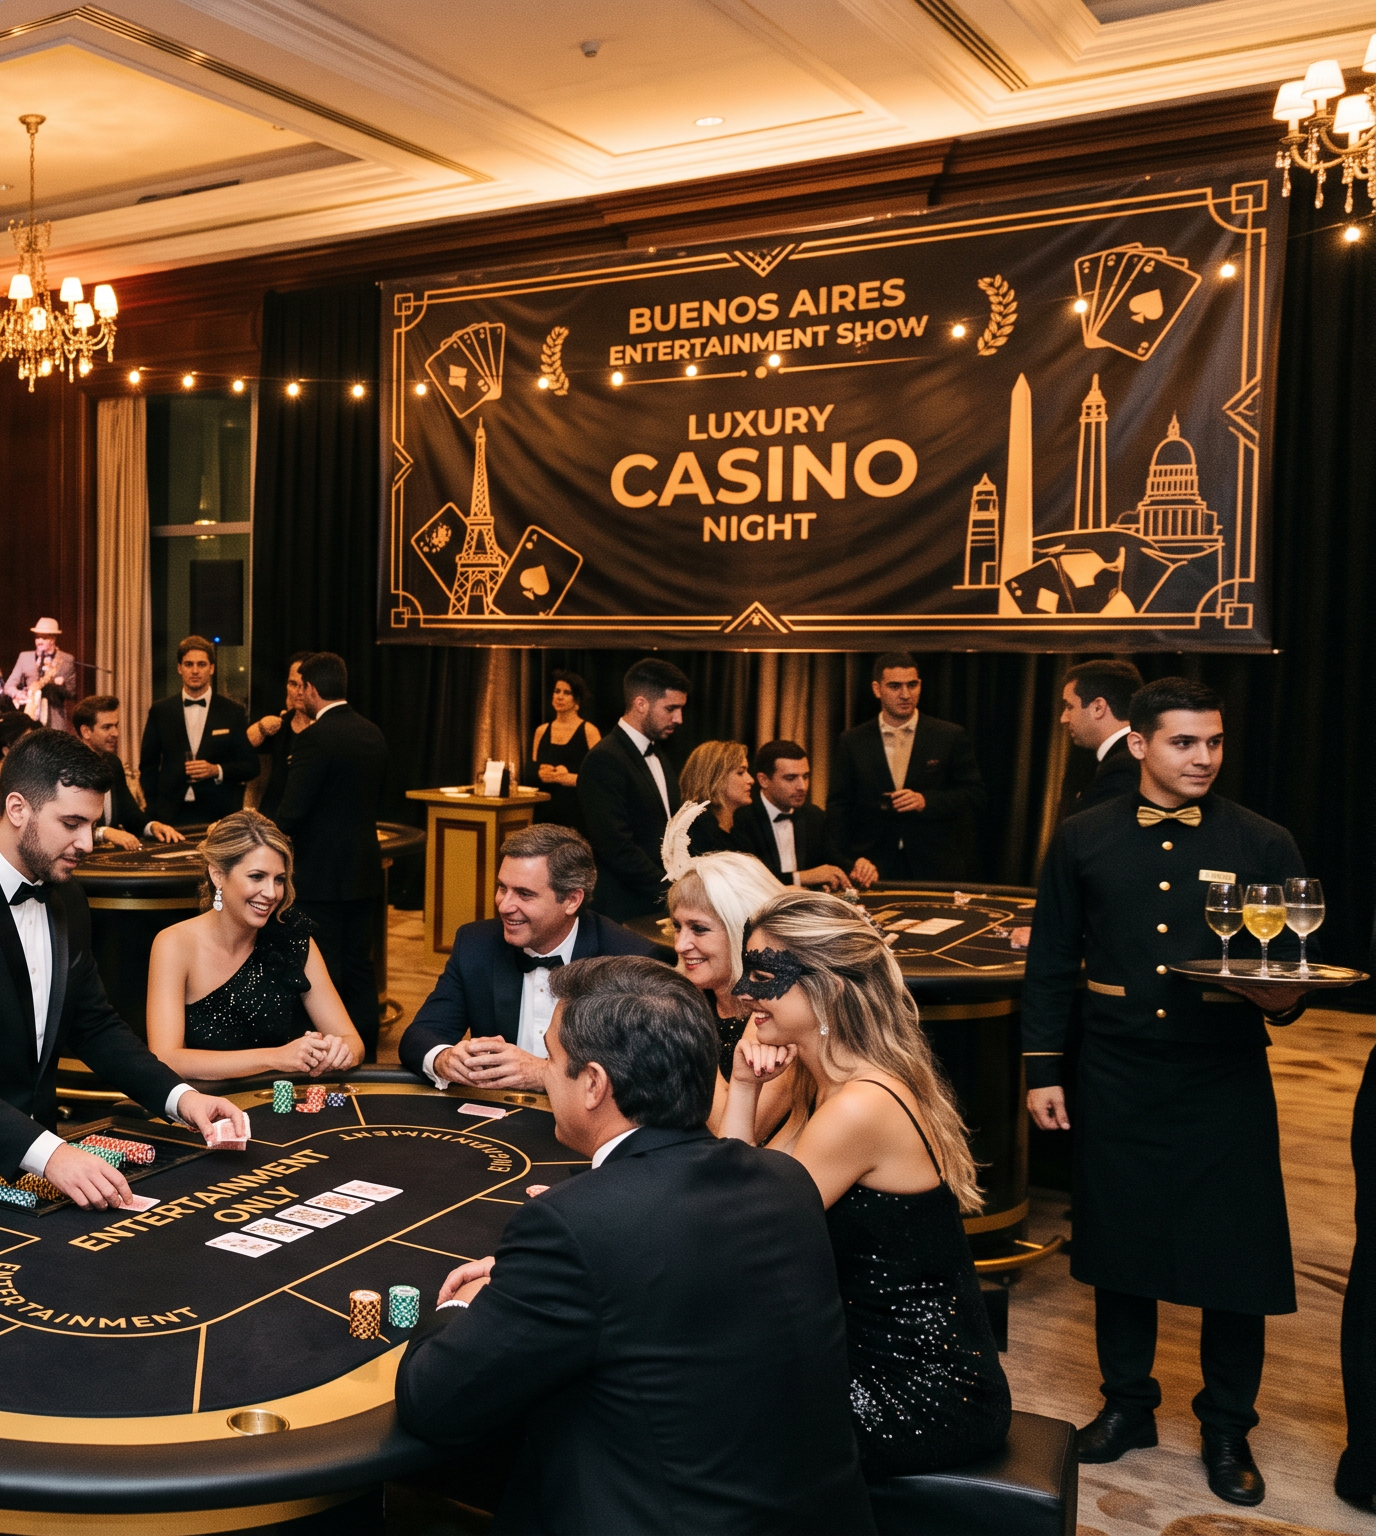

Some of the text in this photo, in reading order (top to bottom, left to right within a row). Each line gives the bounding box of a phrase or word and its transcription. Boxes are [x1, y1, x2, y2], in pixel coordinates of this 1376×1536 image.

[629, 278, 906, 335] BUENOS AIRES
[609, 315, 929, 366] ENTERTAINMENT SHOW
[688, 404, 835, 441] LUXURY
[610, 438, 919, 508] CASINO
[703, 512, 817, 542] NIGHT
[68, 1149, 330, 1252] ENTERTAINMENT
[213, 1186, 300, 1223] ONLY
